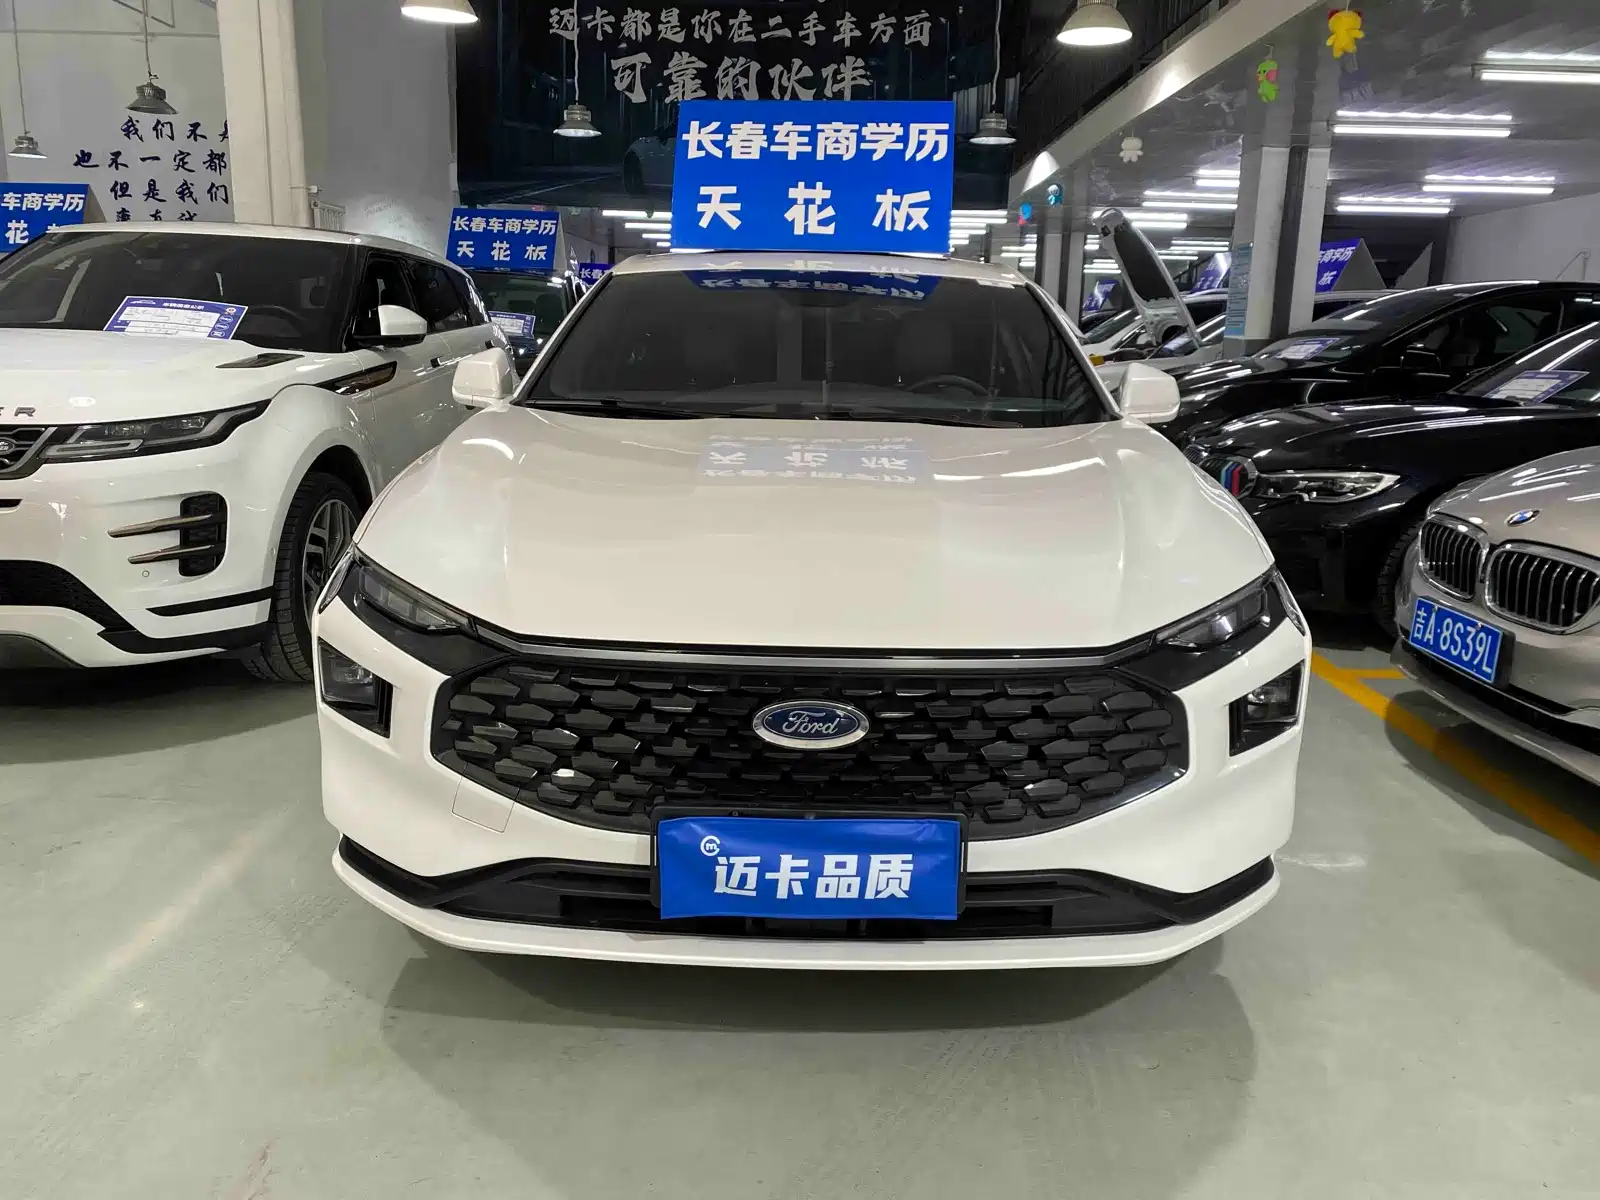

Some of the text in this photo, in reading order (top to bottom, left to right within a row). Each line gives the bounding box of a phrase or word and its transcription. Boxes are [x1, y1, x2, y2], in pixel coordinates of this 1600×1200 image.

[549, 7, 932, 48] 迈卡都是你在二手车方面
[611, 51, 872, 103] 可靠的伙伴
[682, 121, 949, 162] 长春车商学历
[73, 149, 227, 176] 也不一定都
[1, 192, 85, 212] 车商学历
[110, 179, 228, 204] 但是我们
[697, 182, 931, 235] 天花板
[453, 215, 556, 235] 长春车商学历
[457, 240, 548, 261] 天花板
[782, 710, 840, 734] Ford
[714, 853, 913, 900] 迈卡品质
